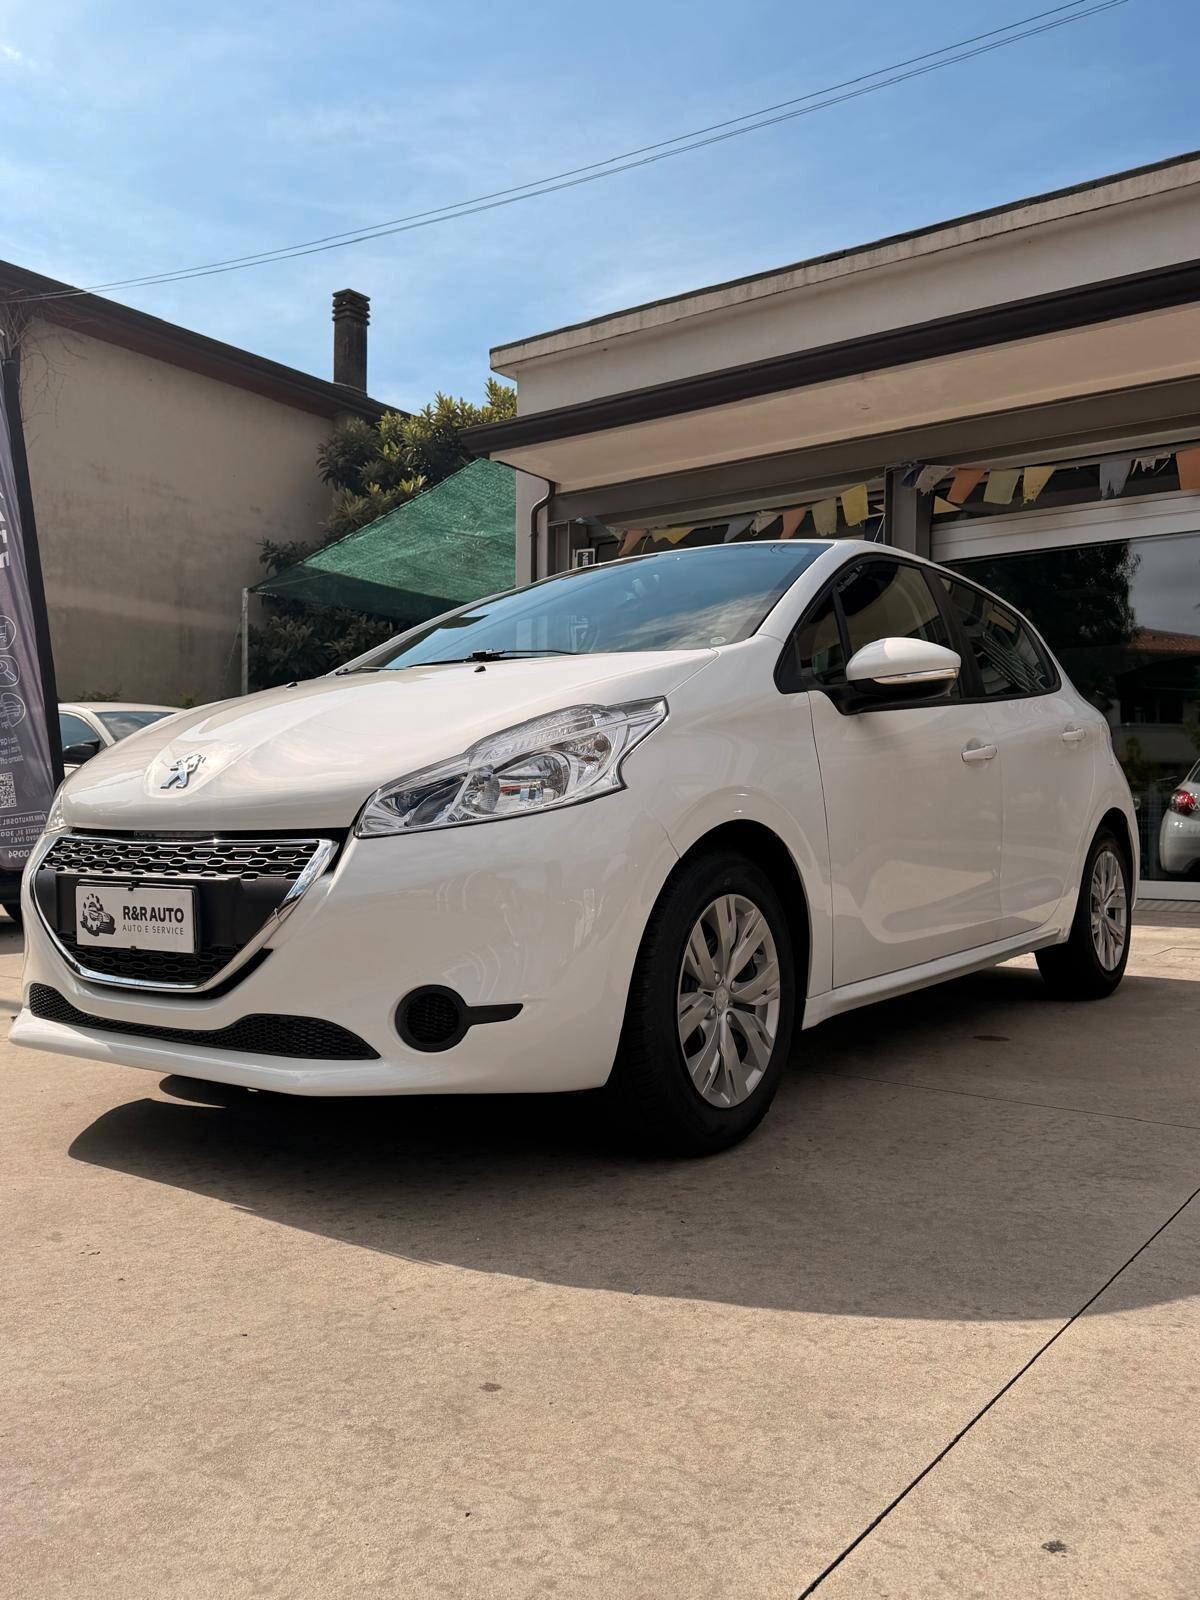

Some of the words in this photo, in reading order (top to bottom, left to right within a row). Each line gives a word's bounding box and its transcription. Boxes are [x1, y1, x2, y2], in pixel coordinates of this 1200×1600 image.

[122, 905, 148, 922] R&R
[149, 907, 185, 923] AUTO
[122, 924, 142, 933] AUTO
[145, 925, 149, 933] E
[152, 926, 184, 935] SERVICE
